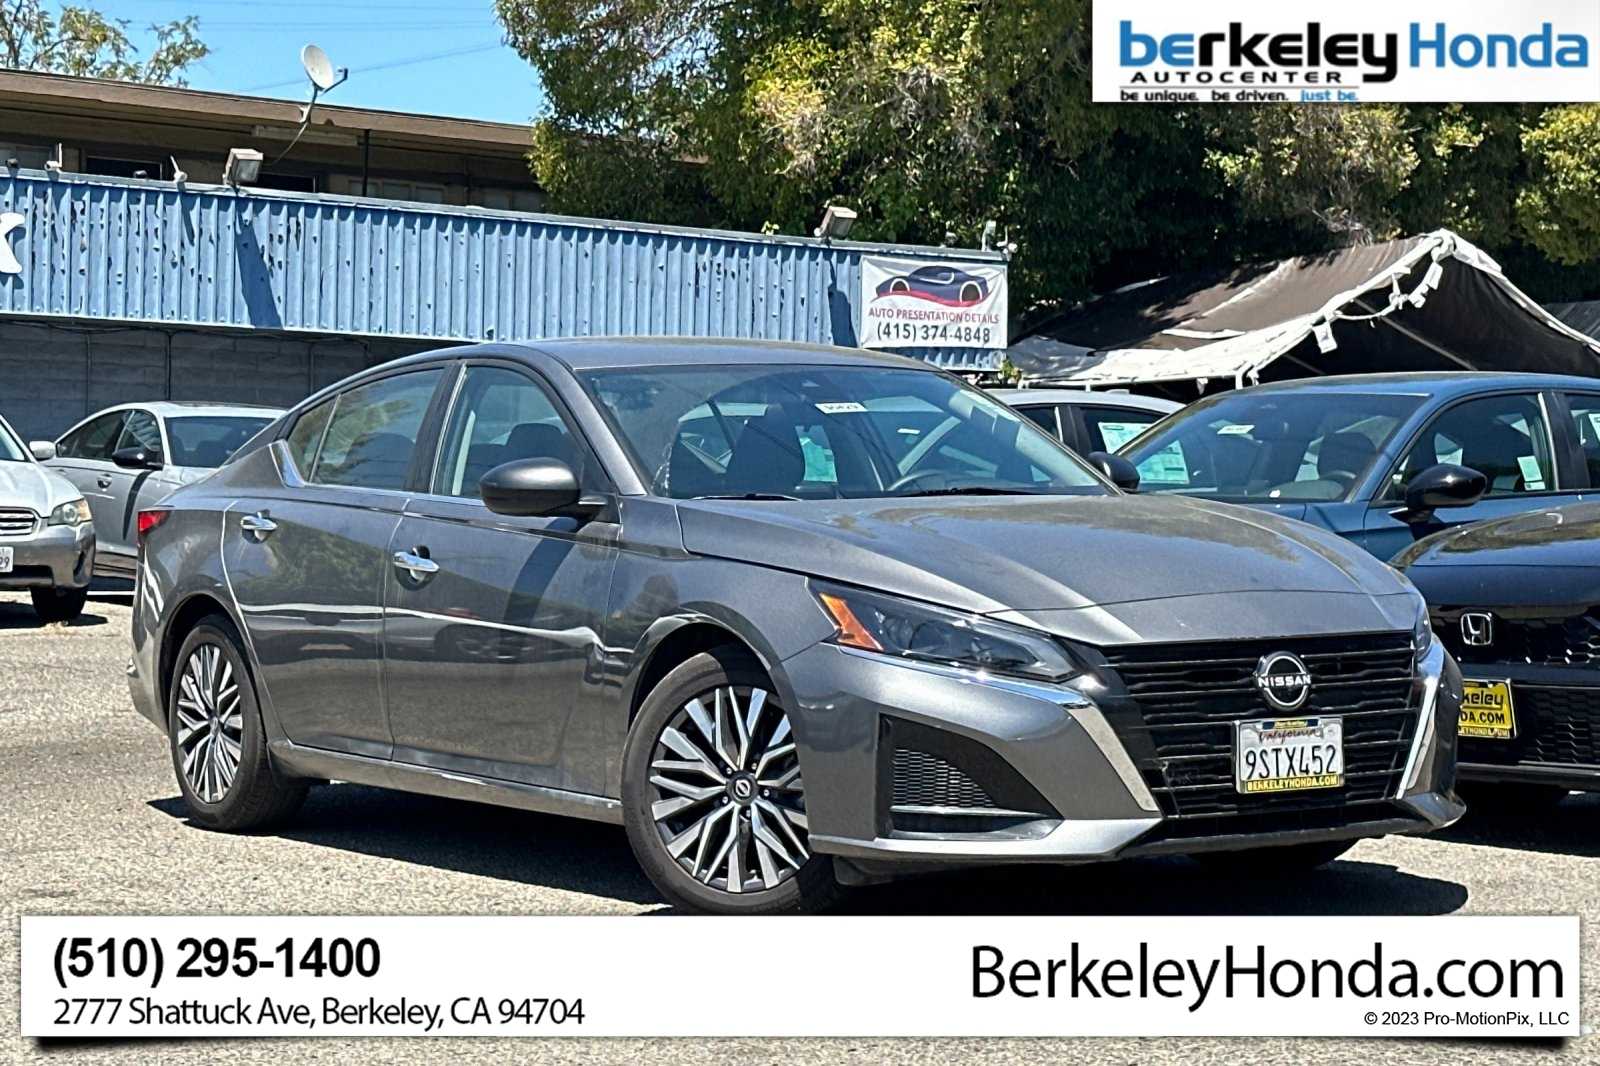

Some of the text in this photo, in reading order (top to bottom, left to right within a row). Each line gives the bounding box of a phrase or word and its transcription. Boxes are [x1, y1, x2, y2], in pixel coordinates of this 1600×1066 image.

[868, 307, 1000, 324] AUTO PRESENTATION DETAILS
[877, 322, 991, 344] (415) 374-4848
[1257, 674, 1312, 688] NISSAN
[1245, 744, 1337, 780] 9STX452
[1247, 775, 1338, 792] BERKELEYHONDA.COM
